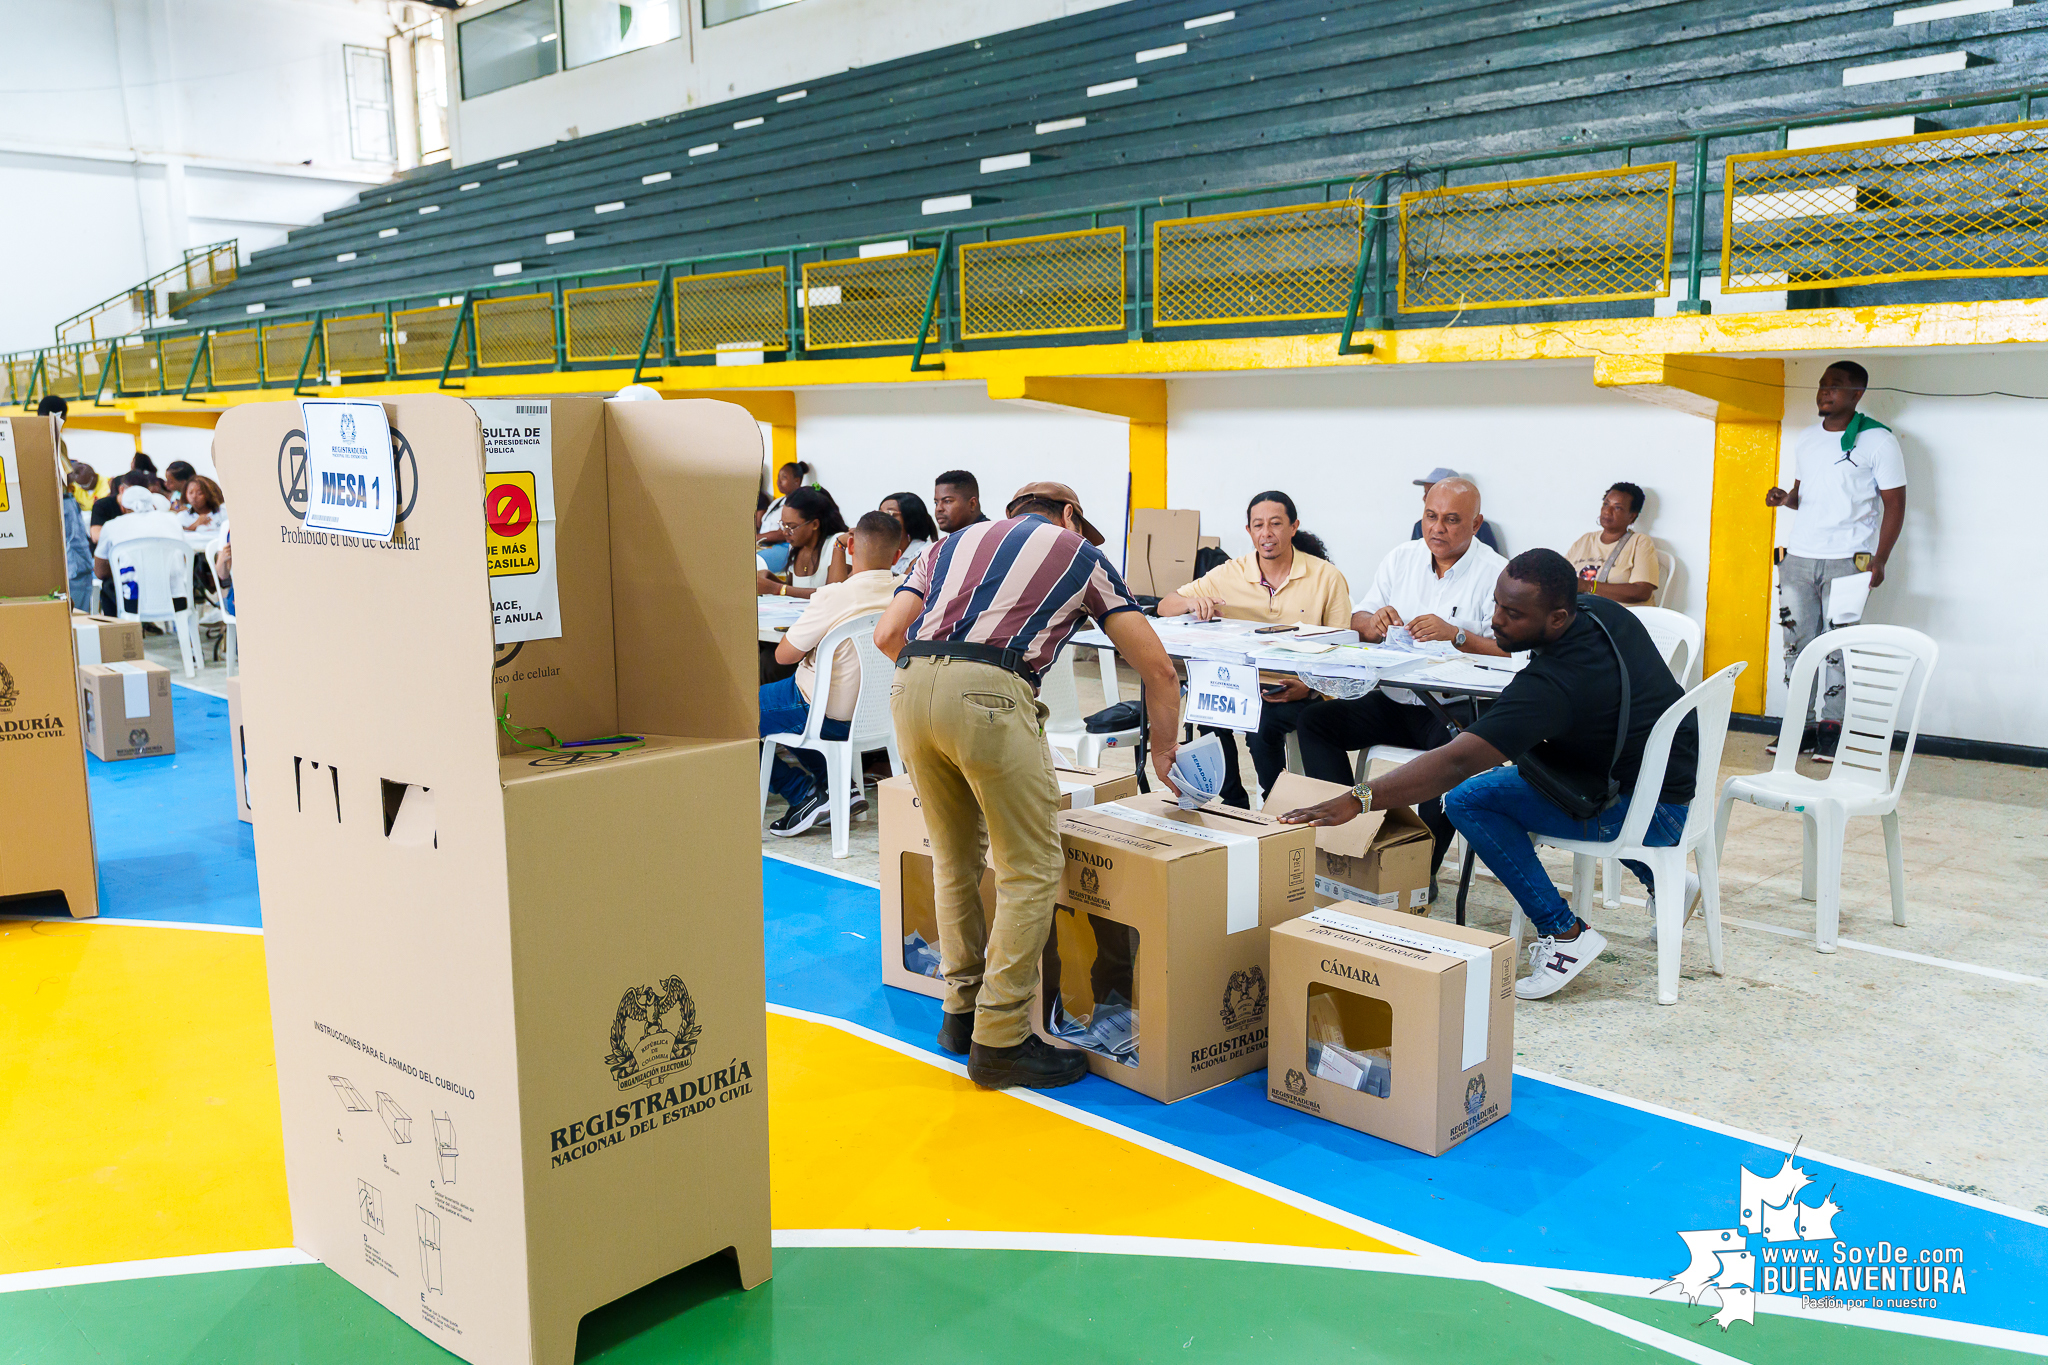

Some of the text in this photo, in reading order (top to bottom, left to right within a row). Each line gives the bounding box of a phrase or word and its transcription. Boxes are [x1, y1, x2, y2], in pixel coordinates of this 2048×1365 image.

[525, 428, 541, 437] DE
[321, 471, 380, 510] MESA 1
[281, 525, 328, 543] Prohibido
[502, 543, 527, 555] MÁS
[488, 557, 535, 570] CASILLA
[505, 611, 543, 624] ANULA
[512, 670, 525, 682] de
[527, 666, 561, 680] celular
[1197, 692, 1248, 716] MESA 1
[37, 730, 65, 738] CIVIL
[1191, 754, 1207, 782] SENADO
[1068, 847, 1113, 870] SENADO
[1069, 889, 1111, 907] REGISTRADURÍA
[1332, 933, 1361, 943] VOTO
[1374, 943, 1430, 961] DEPOSITE
[1545, 951, 1579, 974] H
[1320, 959, 1381, 987] CÁMARA
[641, 1039, 668, 1053] REPÚBLICA
[314, 1020, 475, 1100] INSTRUCCIONES PARA EL ARMADO DEL CUBICULO
[641, 1053, 669, 1067] COLOMBIA
[1190, 1055, 1228, 1073] NACIONAL
[1229, 1048, 1244, 1060] DEL
[620, 1059, 690, 1088] ORGANIZACIÓN ELECTORAL
[550, 1058, 753, 1152] REGISTRADURÍA
[1272, 1088, 1321, 1109] REGISTRADURÍA
[551, 1083, 753, 1170] NACIONAL DEL ESTADO CIVIL
[1449, 1102, 1499, 1137] REGISTRADURÍA
[336, 1128, 342, 1136] A
[383, 1153, 388, 1163] B
[430, 1179, 436, 1189] C
[363, 1233, 368, 1242] D
[420, 1291, 426, 1303] E
